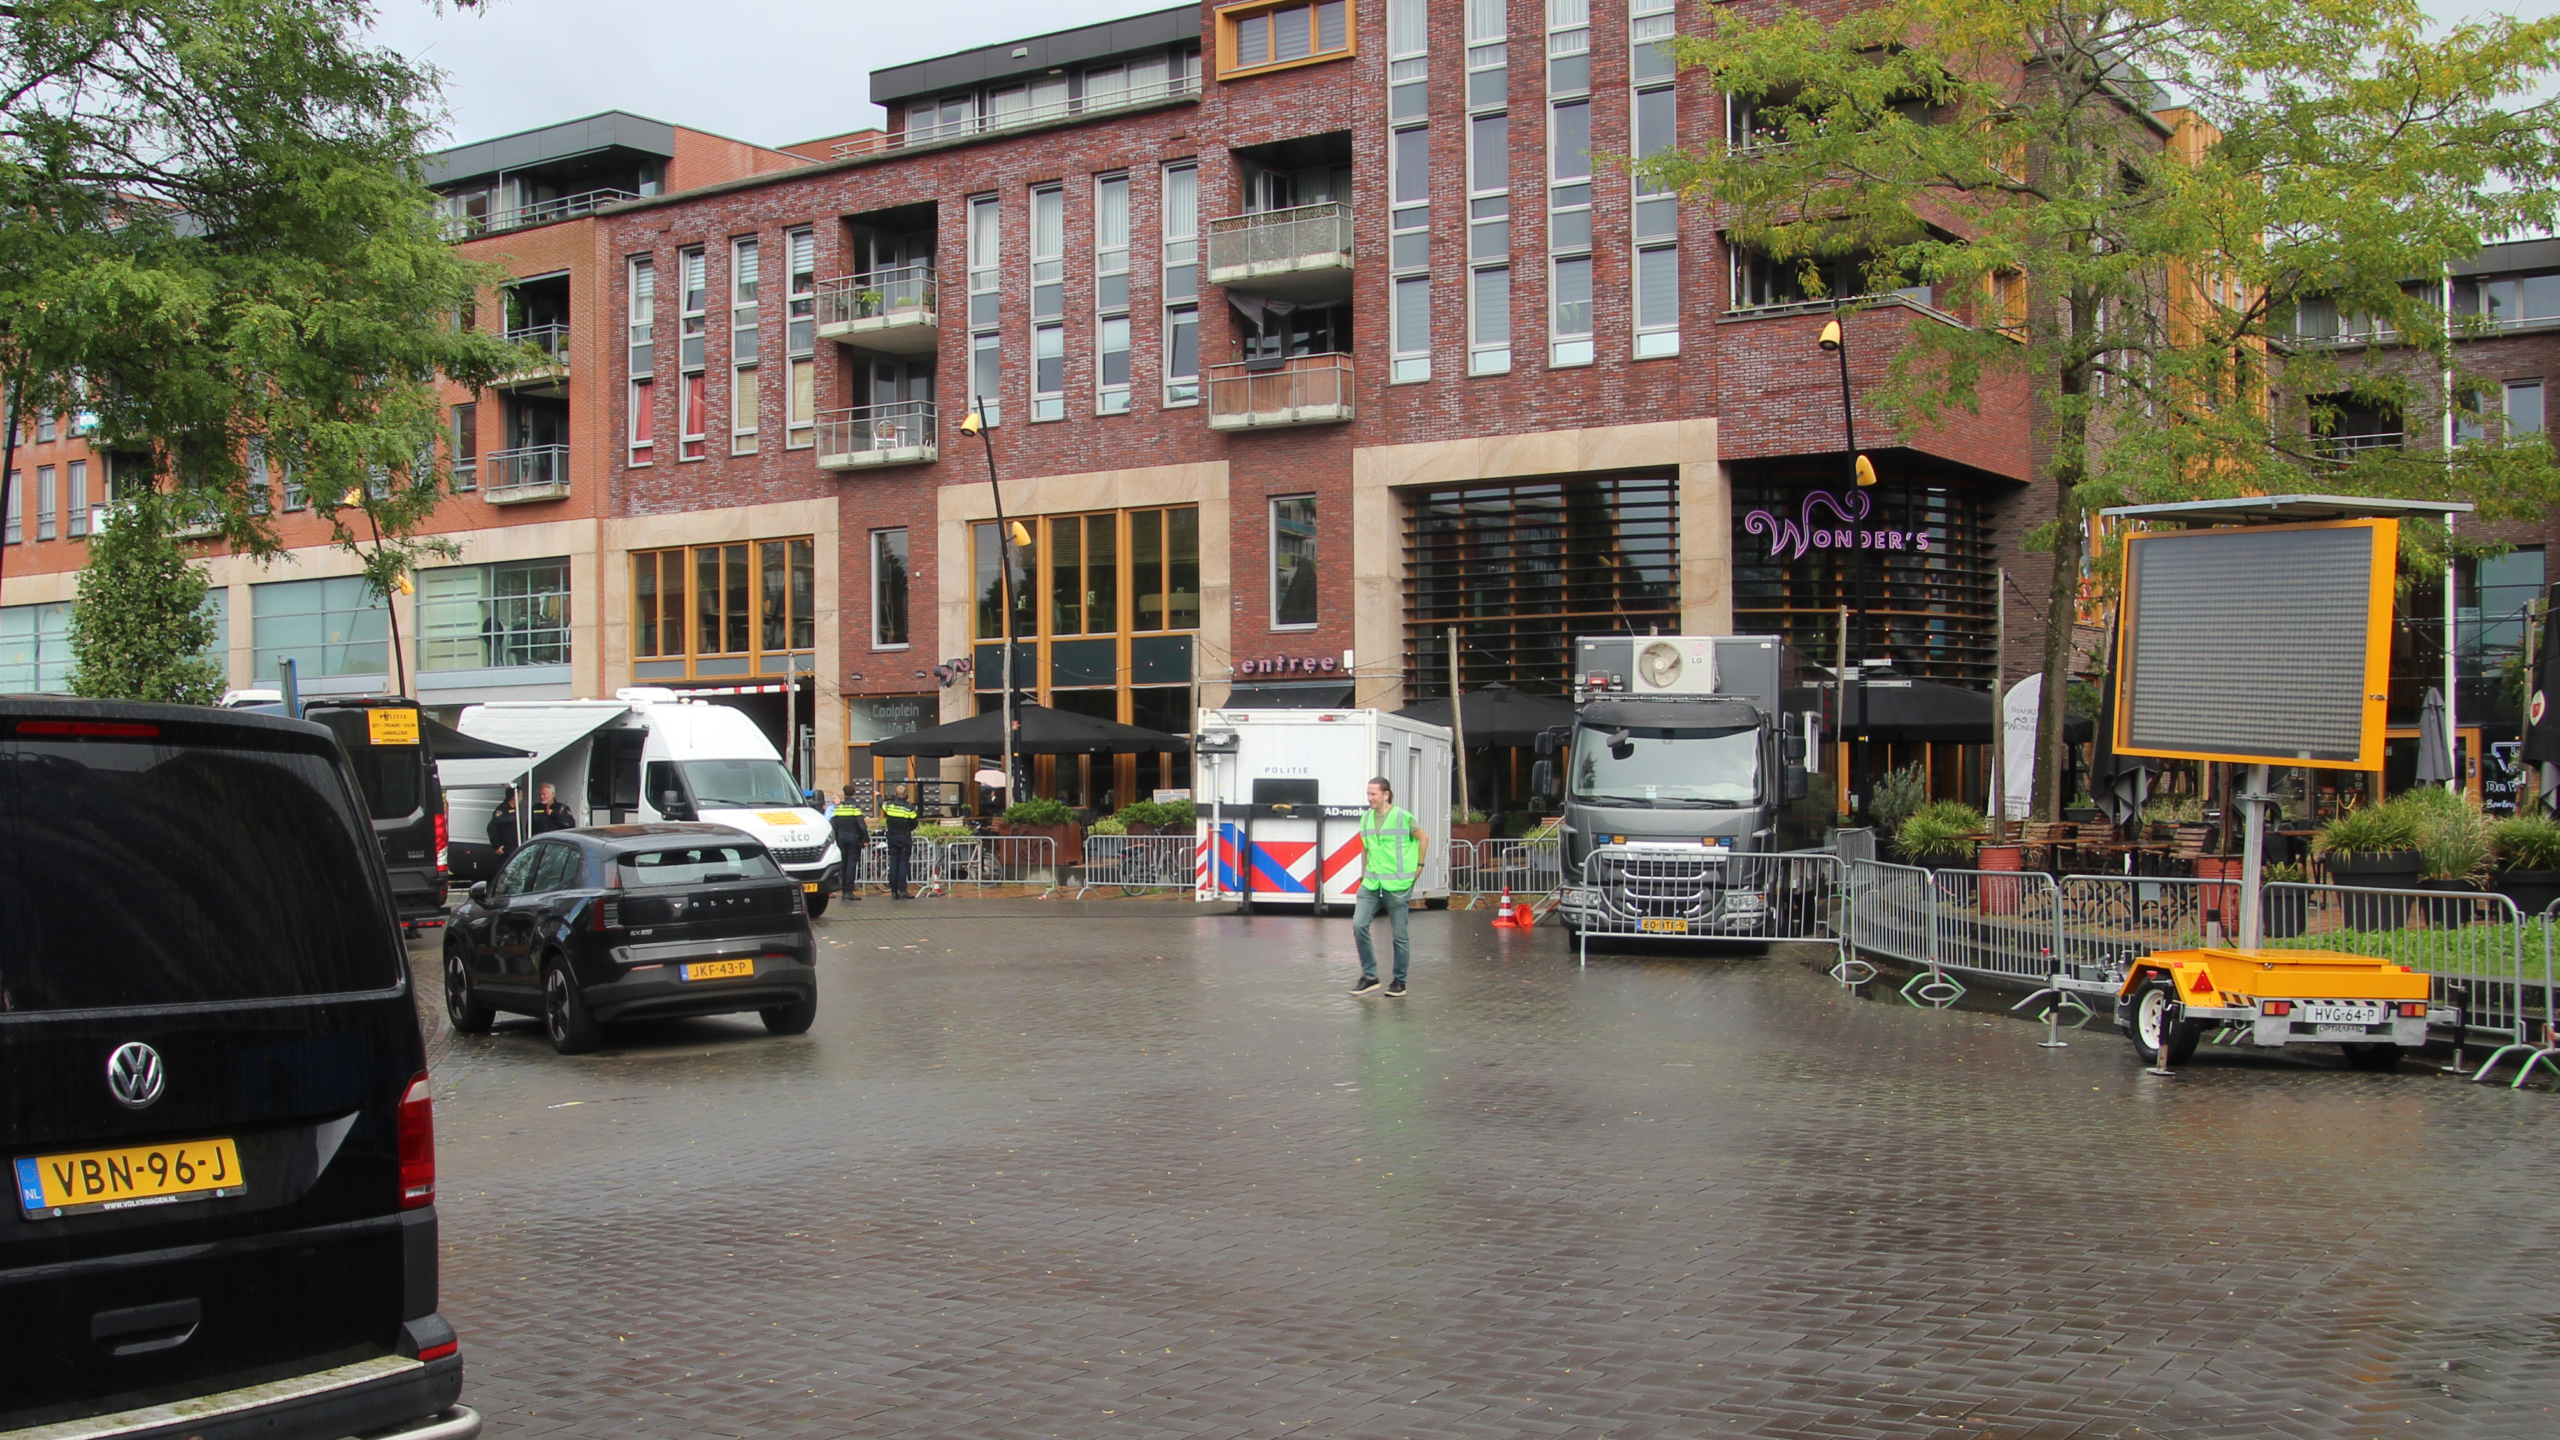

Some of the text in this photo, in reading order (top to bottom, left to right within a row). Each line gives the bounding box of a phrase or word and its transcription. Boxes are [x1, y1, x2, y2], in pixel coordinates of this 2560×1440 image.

[1241, 655, 1336, 674] entree
[1691, 657, 1703, 665] LG
[873, 703, 919, 720] Coolplein
[905, 722, 917, 733] 28
[1264, 766, 1309, 774] POLITIE
[673, 897, 751, 909] VOLVO
[693, 962, 746, 978] JKF-43-P
[2315, 1008, 2375, 1022] HVG-64-P
[2318, 1024, 2364, 1034] OPTRAFFIC
[24, 1146, 226, 1201] NL VBN-96-J
[104, 1197, 178, 1210] WWW.VOLKSWAGEN.NL
